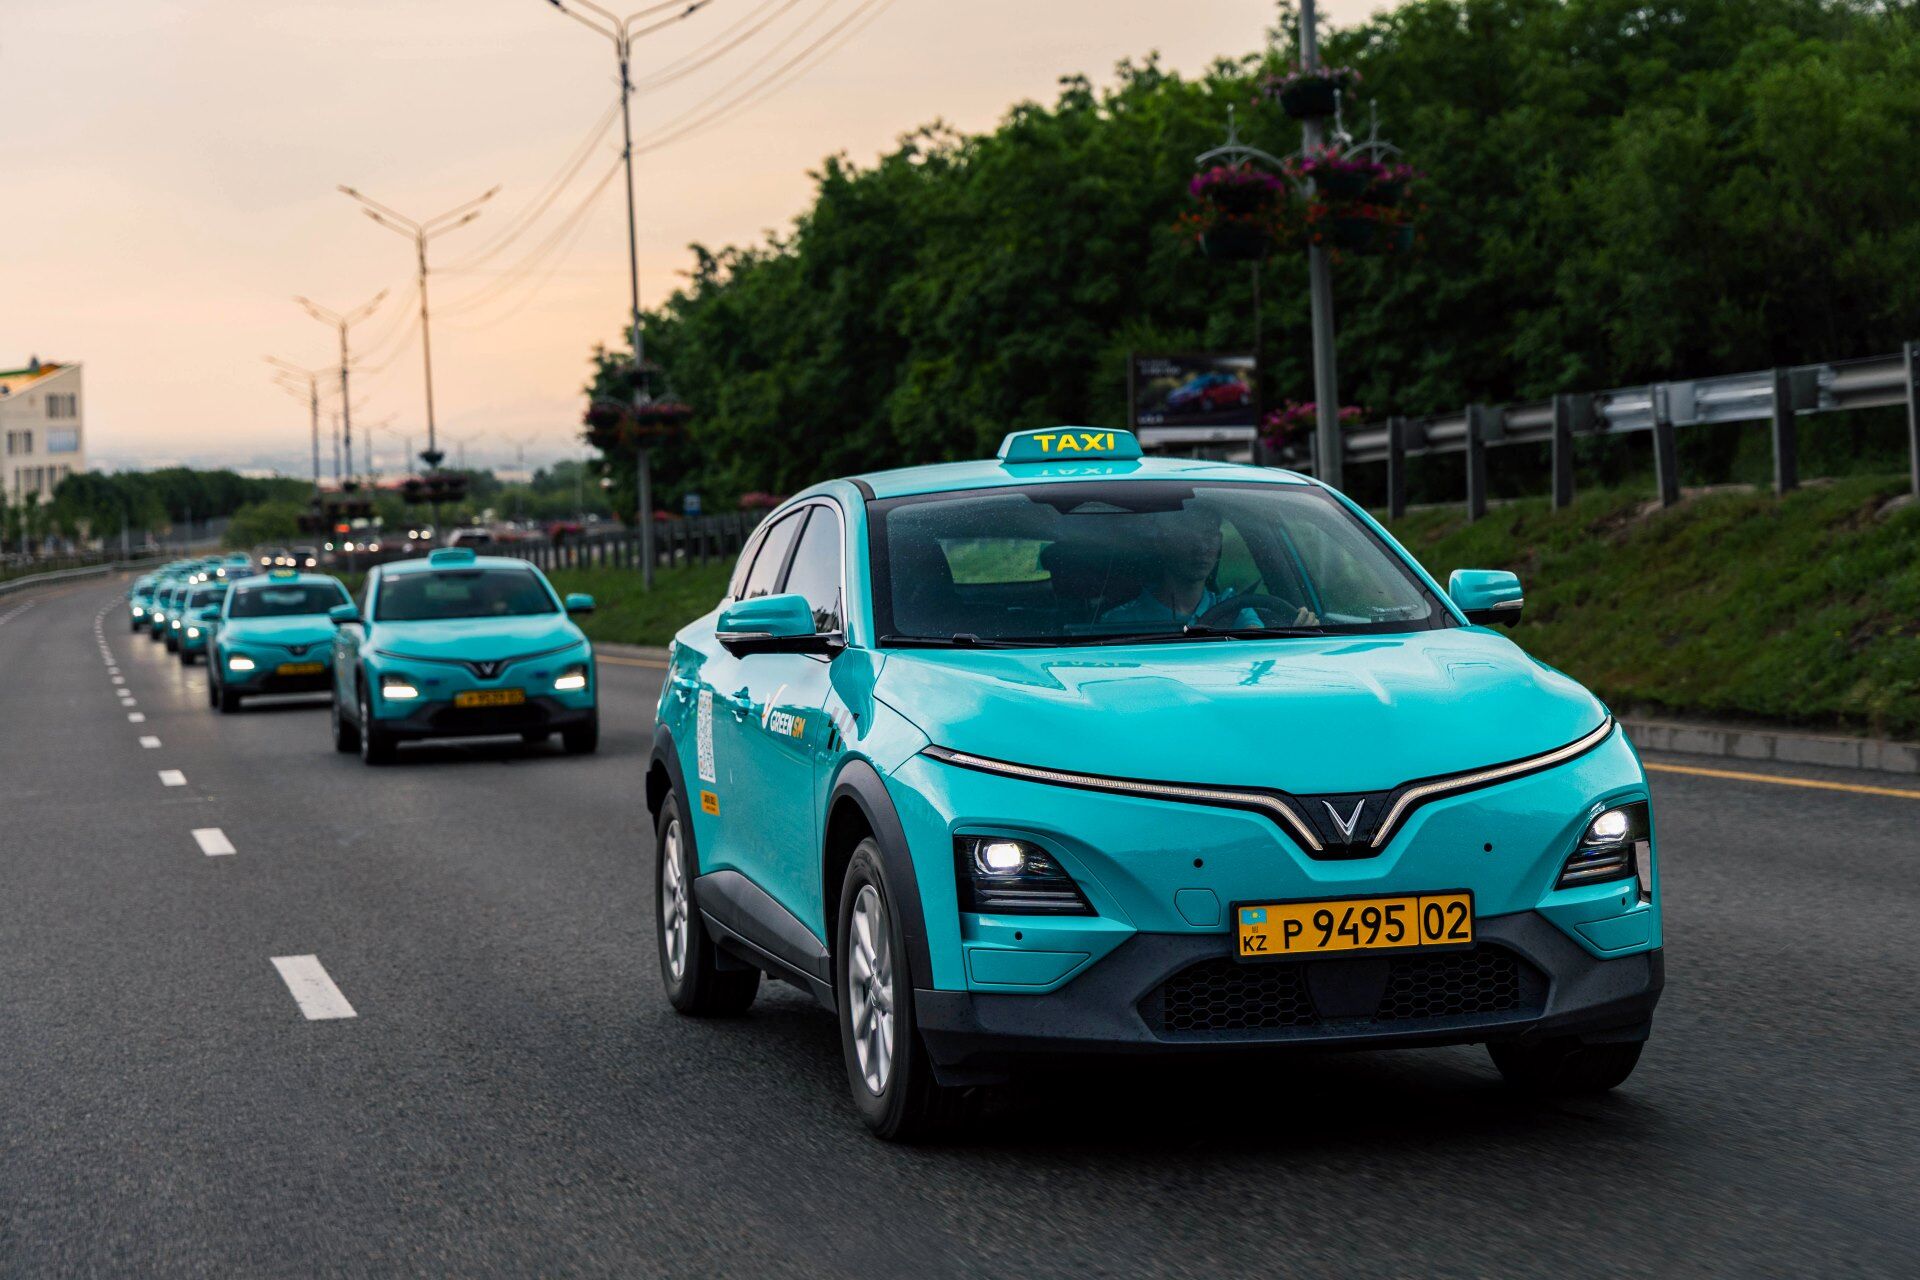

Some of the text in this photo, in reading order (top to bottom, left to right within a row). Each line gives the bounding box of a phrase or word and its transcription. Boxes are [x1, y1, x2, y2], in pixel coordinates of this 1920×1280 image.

[1033, 433, 1115, 452] TAXI
[770, 711, 795, 736] GREEN
[1313, 905, 1406, 947] 9495
[1423, 902, 1469, 940] 02
[1243, 935, 1267, 952] KZ
